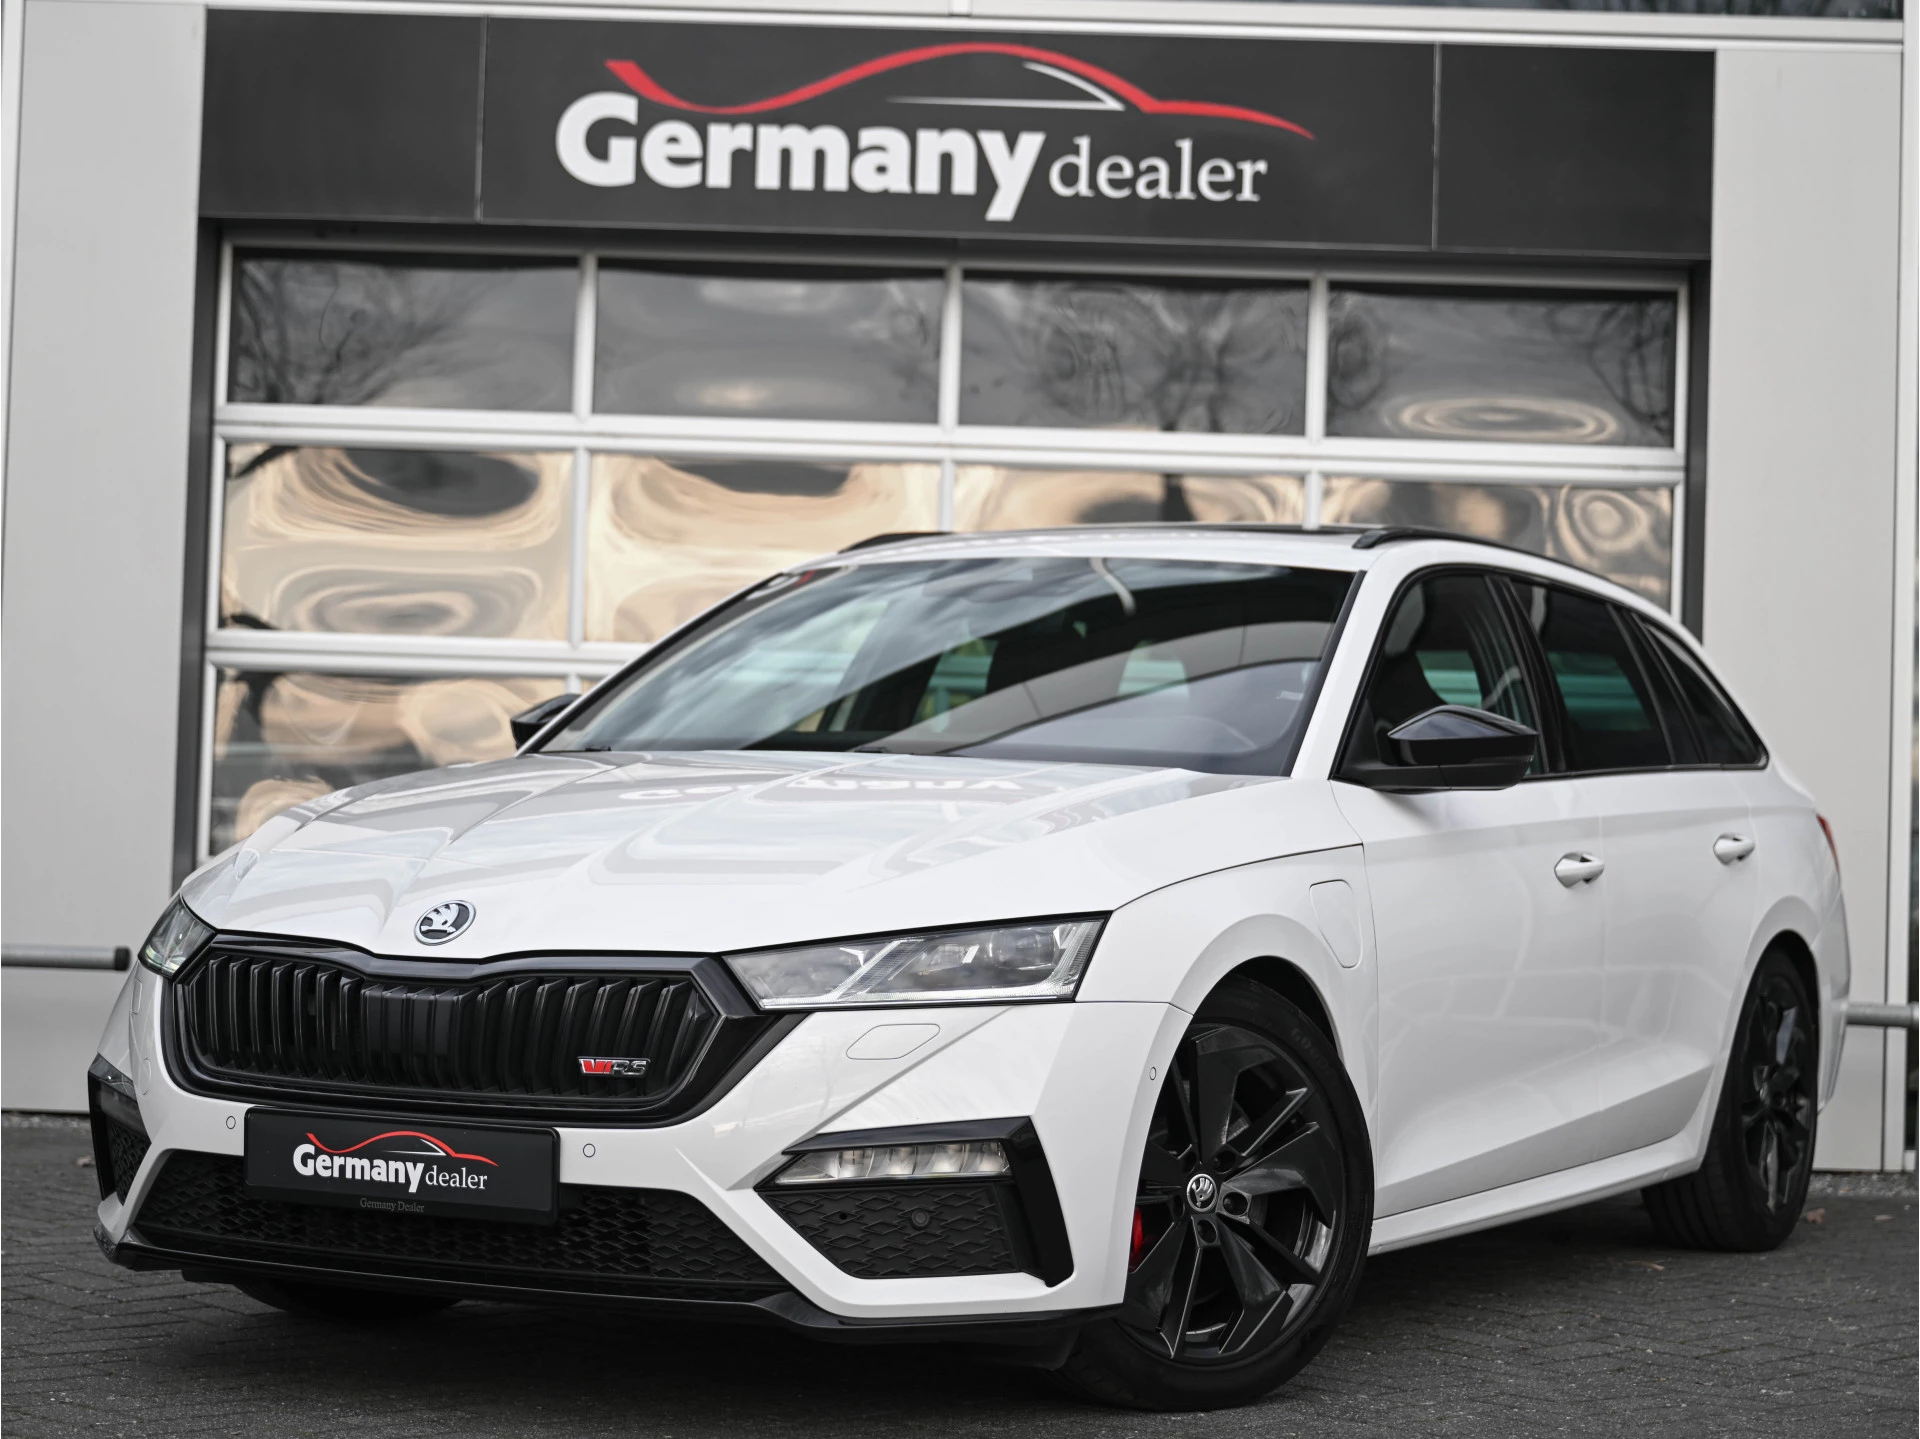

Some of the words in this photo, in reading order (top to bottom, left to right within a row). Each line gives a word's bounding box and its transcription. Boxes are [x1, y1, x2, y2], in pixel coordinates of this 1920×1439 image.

[556, 92, 1046, 221] Germany
[1049, 136, 1268, 202] dealer
[293, 1143, 425, 1193] Germany
[425, 1164, 488, 1190] dealer
[359, 1197, 396, 1212] Germany
[397, 1200, 425, 1213] Dealer
